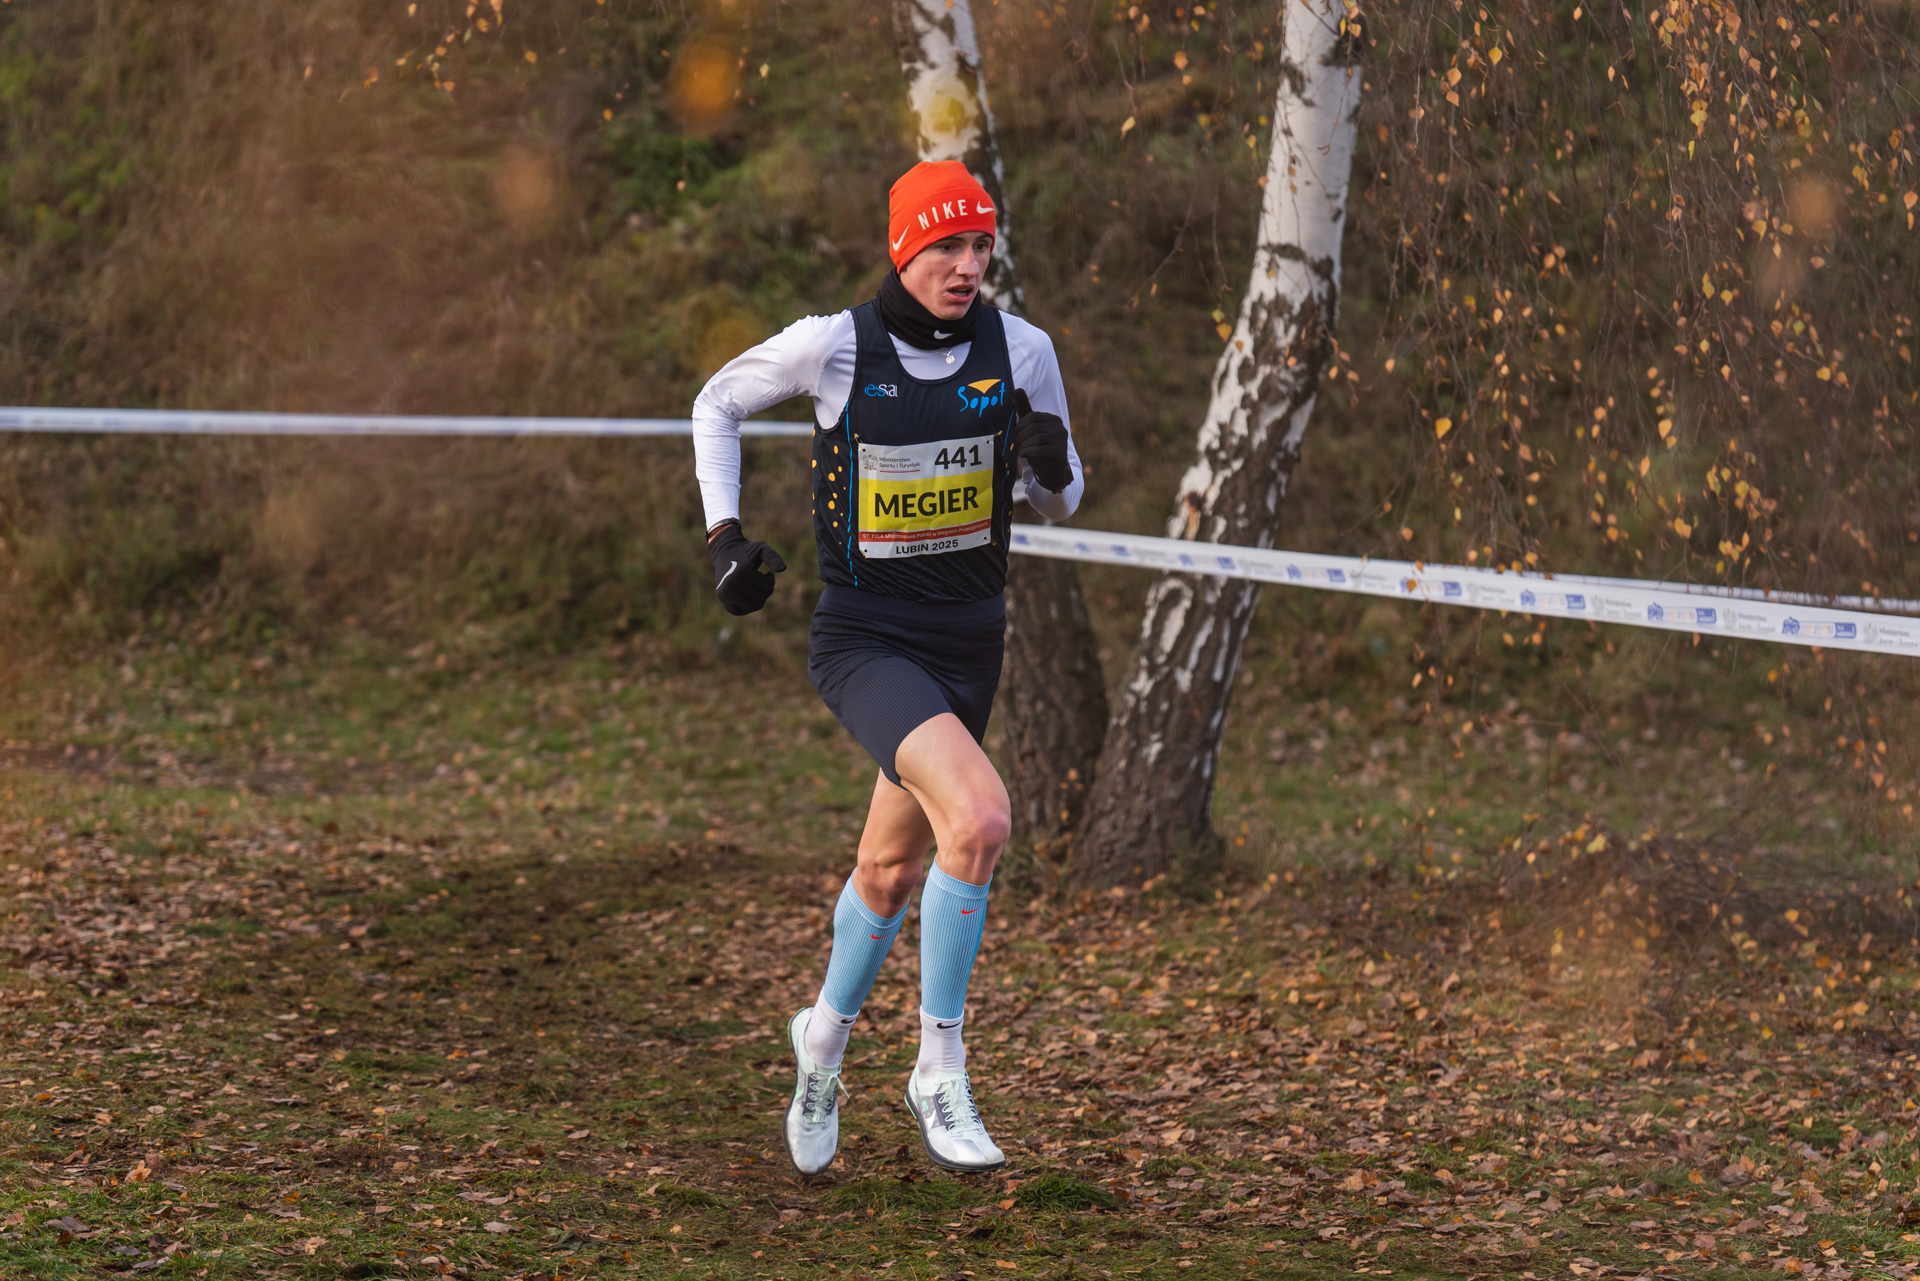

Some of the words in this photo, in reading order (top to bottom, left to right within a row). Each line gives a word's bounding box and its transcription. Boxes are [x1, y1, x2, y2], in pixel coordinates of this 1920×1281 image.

[918, 199, 968, 230] NIKE
[865, 384, 898, 397] esa
[957, 381, 1006, 418] Sopot
[934, 444, 982, 470] 441
[875, 486, 979, 518] MEGIER
[937, 528, 958, 536] Biegach
[895, 543, 929, 555] LUBIN
[931, 539, 959, 551] 2025
